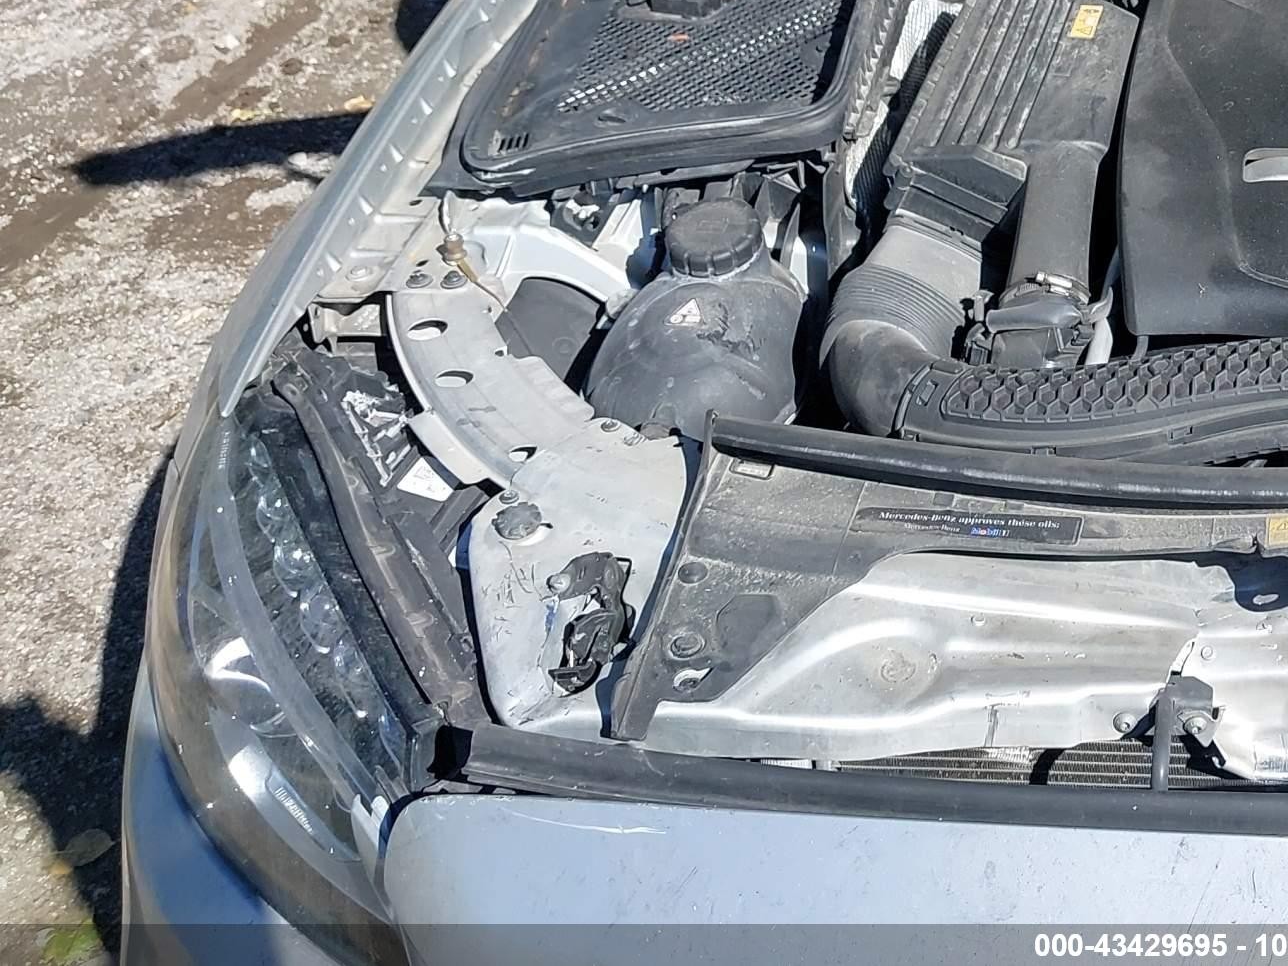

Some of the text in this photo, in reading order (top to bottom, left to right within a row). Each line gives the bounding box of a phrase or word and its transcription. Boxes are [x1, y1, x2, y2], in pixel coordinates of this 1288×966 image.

[878, 511, 956, 522] Mercedes-Benz
[958, 516, 1005, 528] approves
[1007, 518, 1036, 528] these
